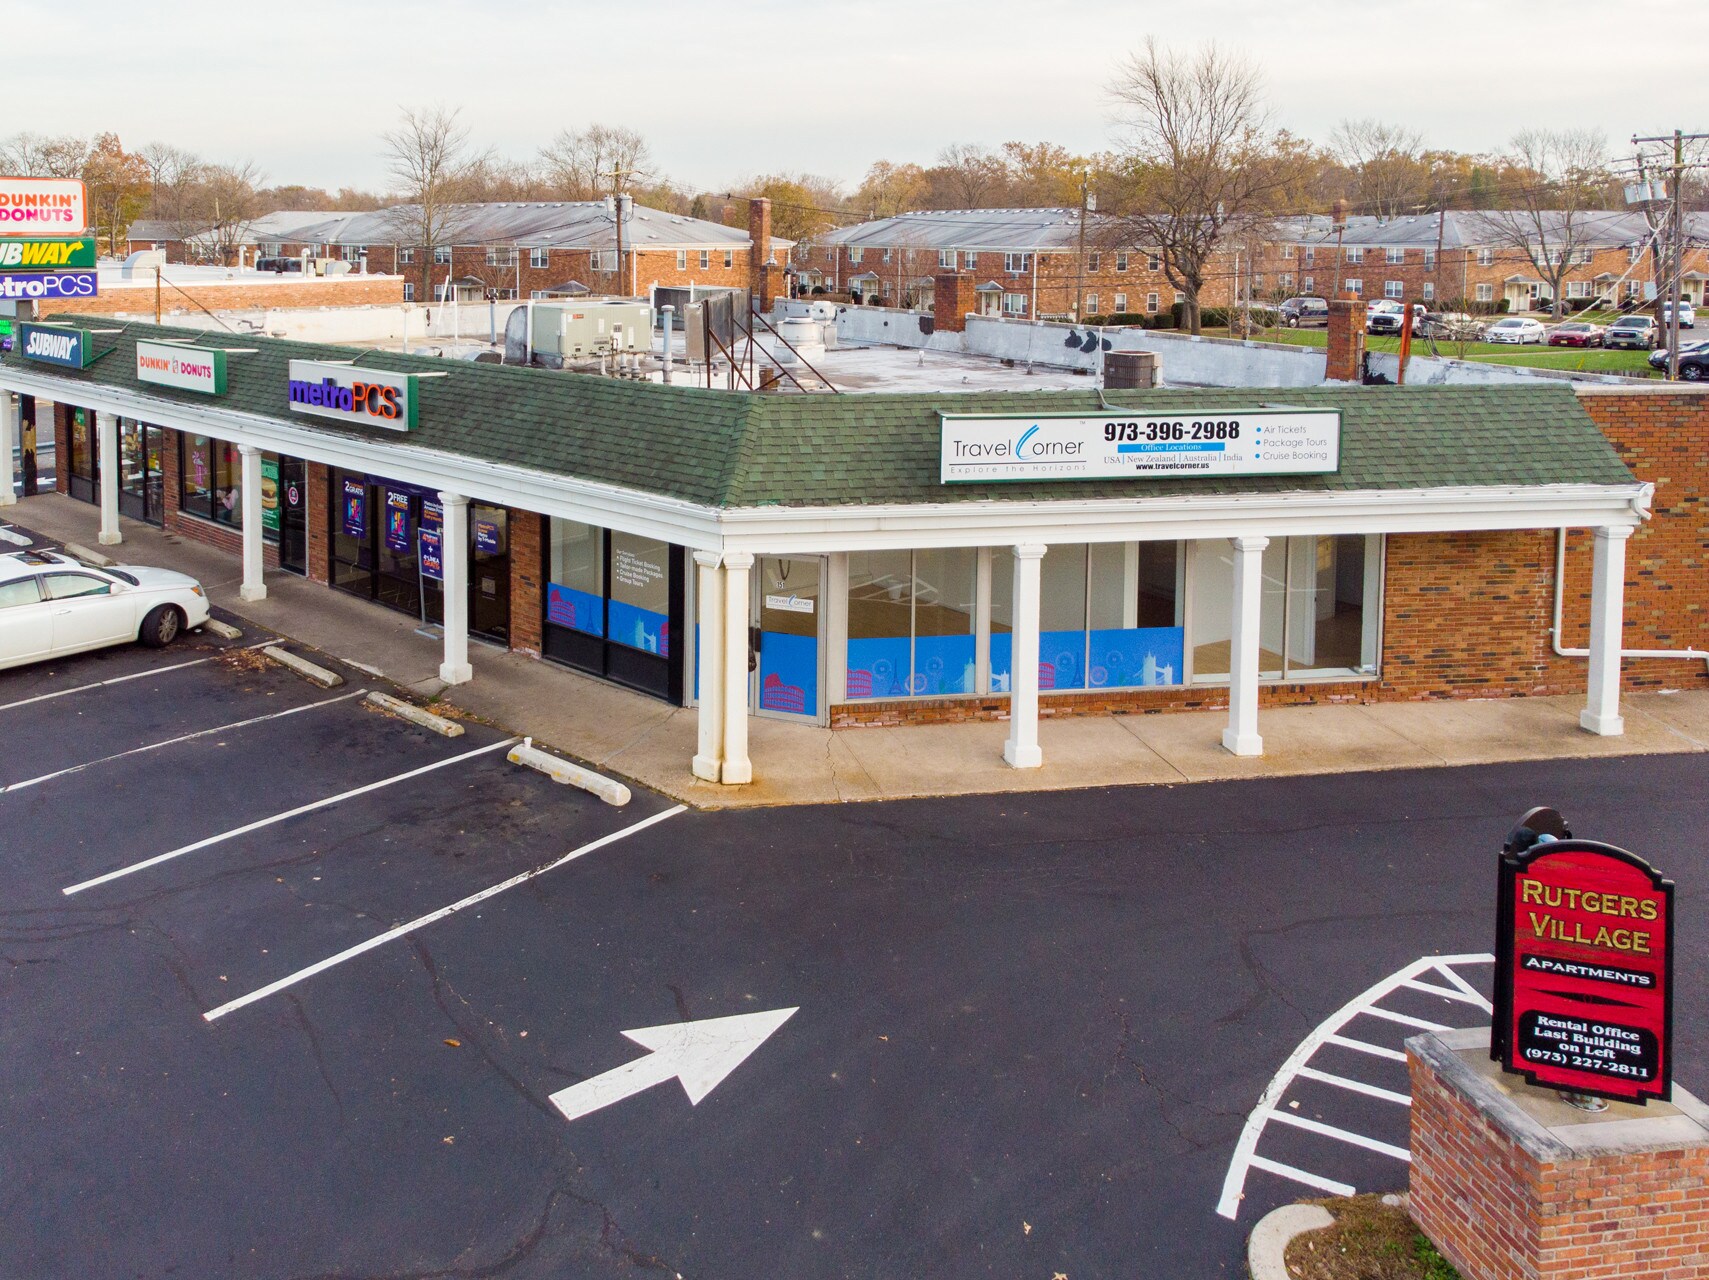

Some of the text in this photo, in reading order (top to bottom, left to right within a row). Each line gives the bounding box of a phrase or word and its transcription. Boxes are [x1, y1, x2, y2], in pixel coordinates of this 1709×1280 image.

[0, 193, 77, 207] DUNKIN'
[0, 208, 73, 222] DONUTS
[0, 241, 84, 265] BWAY
[0, 275, 93, 297] troPCS
[26, 331, 78, 361] SUBWAY
[140, 355, 211, 378] DUNKIN' DONUTS
[289, 377, 398, 419] metroPCS
[1104, 421, 1240, 441] 973-396-2988
[1263, 425, 1307, 434] Air Tickets
[953, 424, 1085, 460] Travel Corner
[1140, 442, 1202, 452] Office Locations
[1263, 438, 1328, 448] Package Tours
[1103, 453, 1243, 464] USA New Zealand Australia India
[1262, 450, 1328, 460] Cruise Booking
[950, 466, 998, 474] Explore
[1135, 462, 1210, 470] www.travelcorner.us
[387, 491, 394, 505] 2
[768, 596, 788, 605] Travel
[1521, 878, 1658, 920] RUTGERS
[1528, 912, 1651, 953] VILLAGE
[1526, 957, 1651, 985] APARTMENTS
[1537, 1015, 1640, 1041] Rental Office
[1534, 1026, 1642, 1055] Last Building
[1558, 1042, 1617, 1059] on Left
[1526, 1047, 1649, 1078] (973) 227-2811
